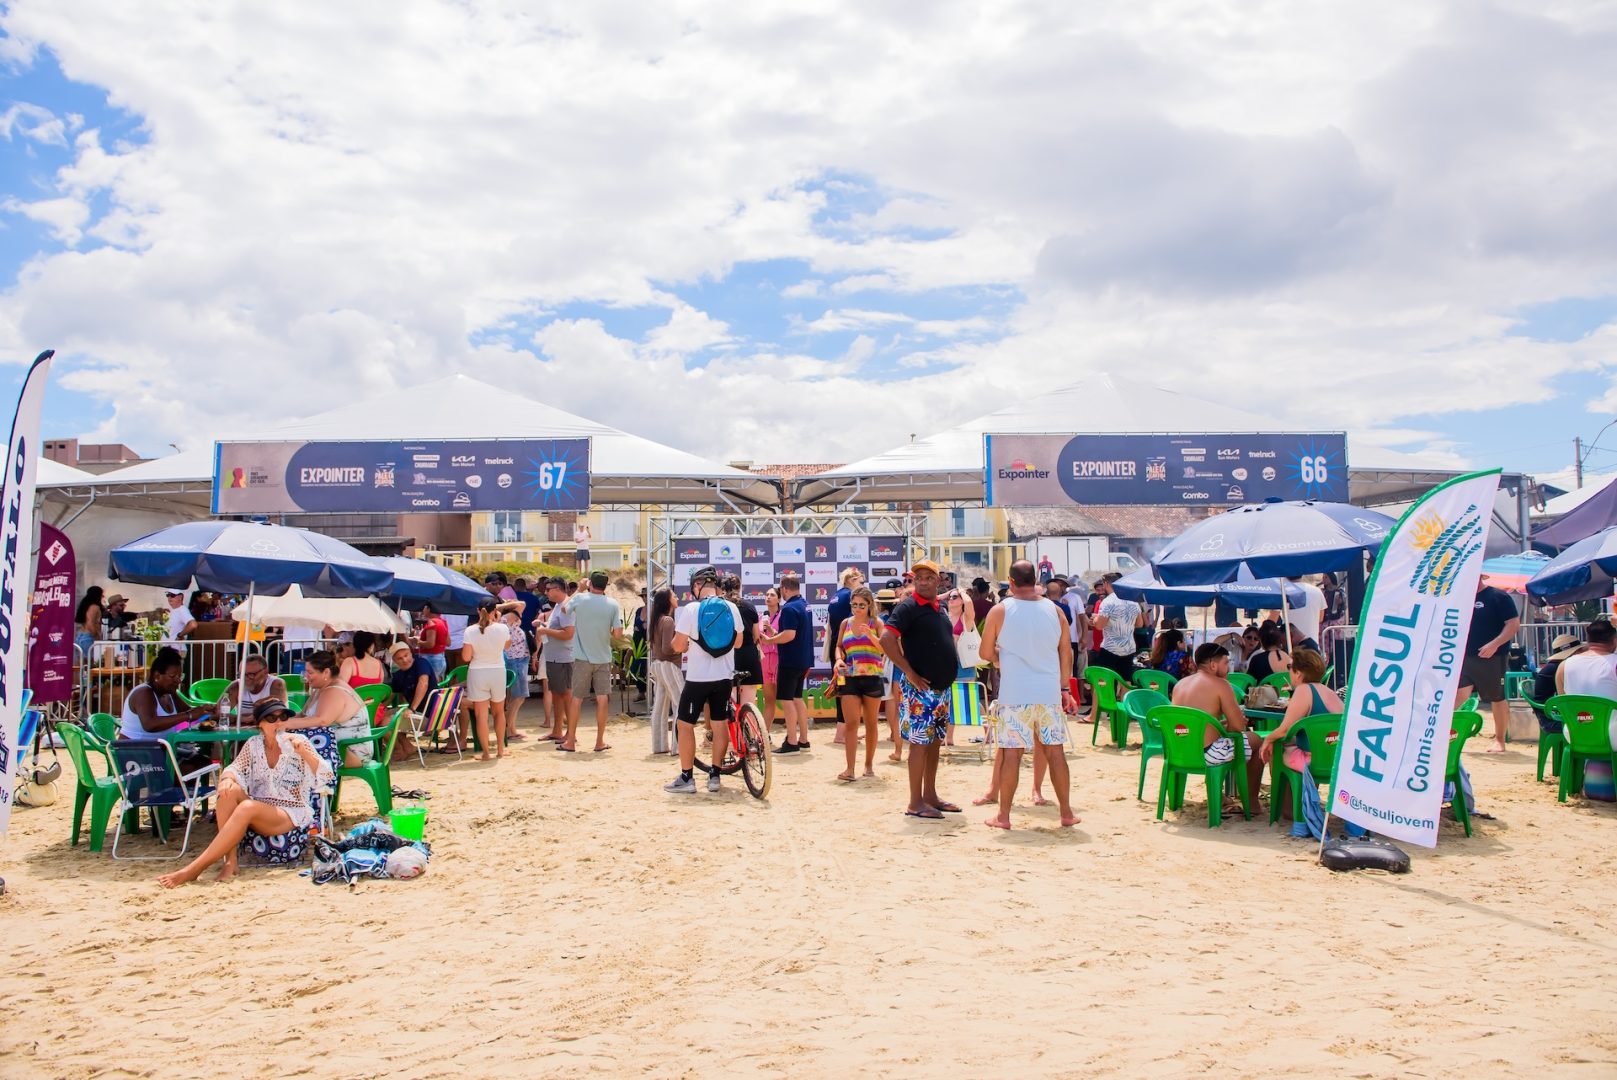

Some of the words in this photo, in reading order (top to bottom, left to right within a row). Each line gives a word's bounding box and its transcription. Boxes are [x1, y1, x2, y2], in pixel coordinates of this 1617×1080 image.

[301, 467, 365, 484] EXPOINTER
[539, 462, 567, 490] 67
[999, 468, 1050, 481] Expointer
[1073, 461, 1136, 476] EXPOINTER
[1301, 456, 1327, 484] 66
[412, 499, 440, 507] Combo
[1278, 538, 1336, 550] banrisul
[680, 552, 707, 560] Expointer
[1236, 583, 1272, 592] banrisul
[1352, 602, 1421, 783] FARSUL
[1407, 689, 1443, 792] Comissão
[1432, 608, 1460, 678] Jovem
[1350, 796, 1435, 830] @farsuljovem
